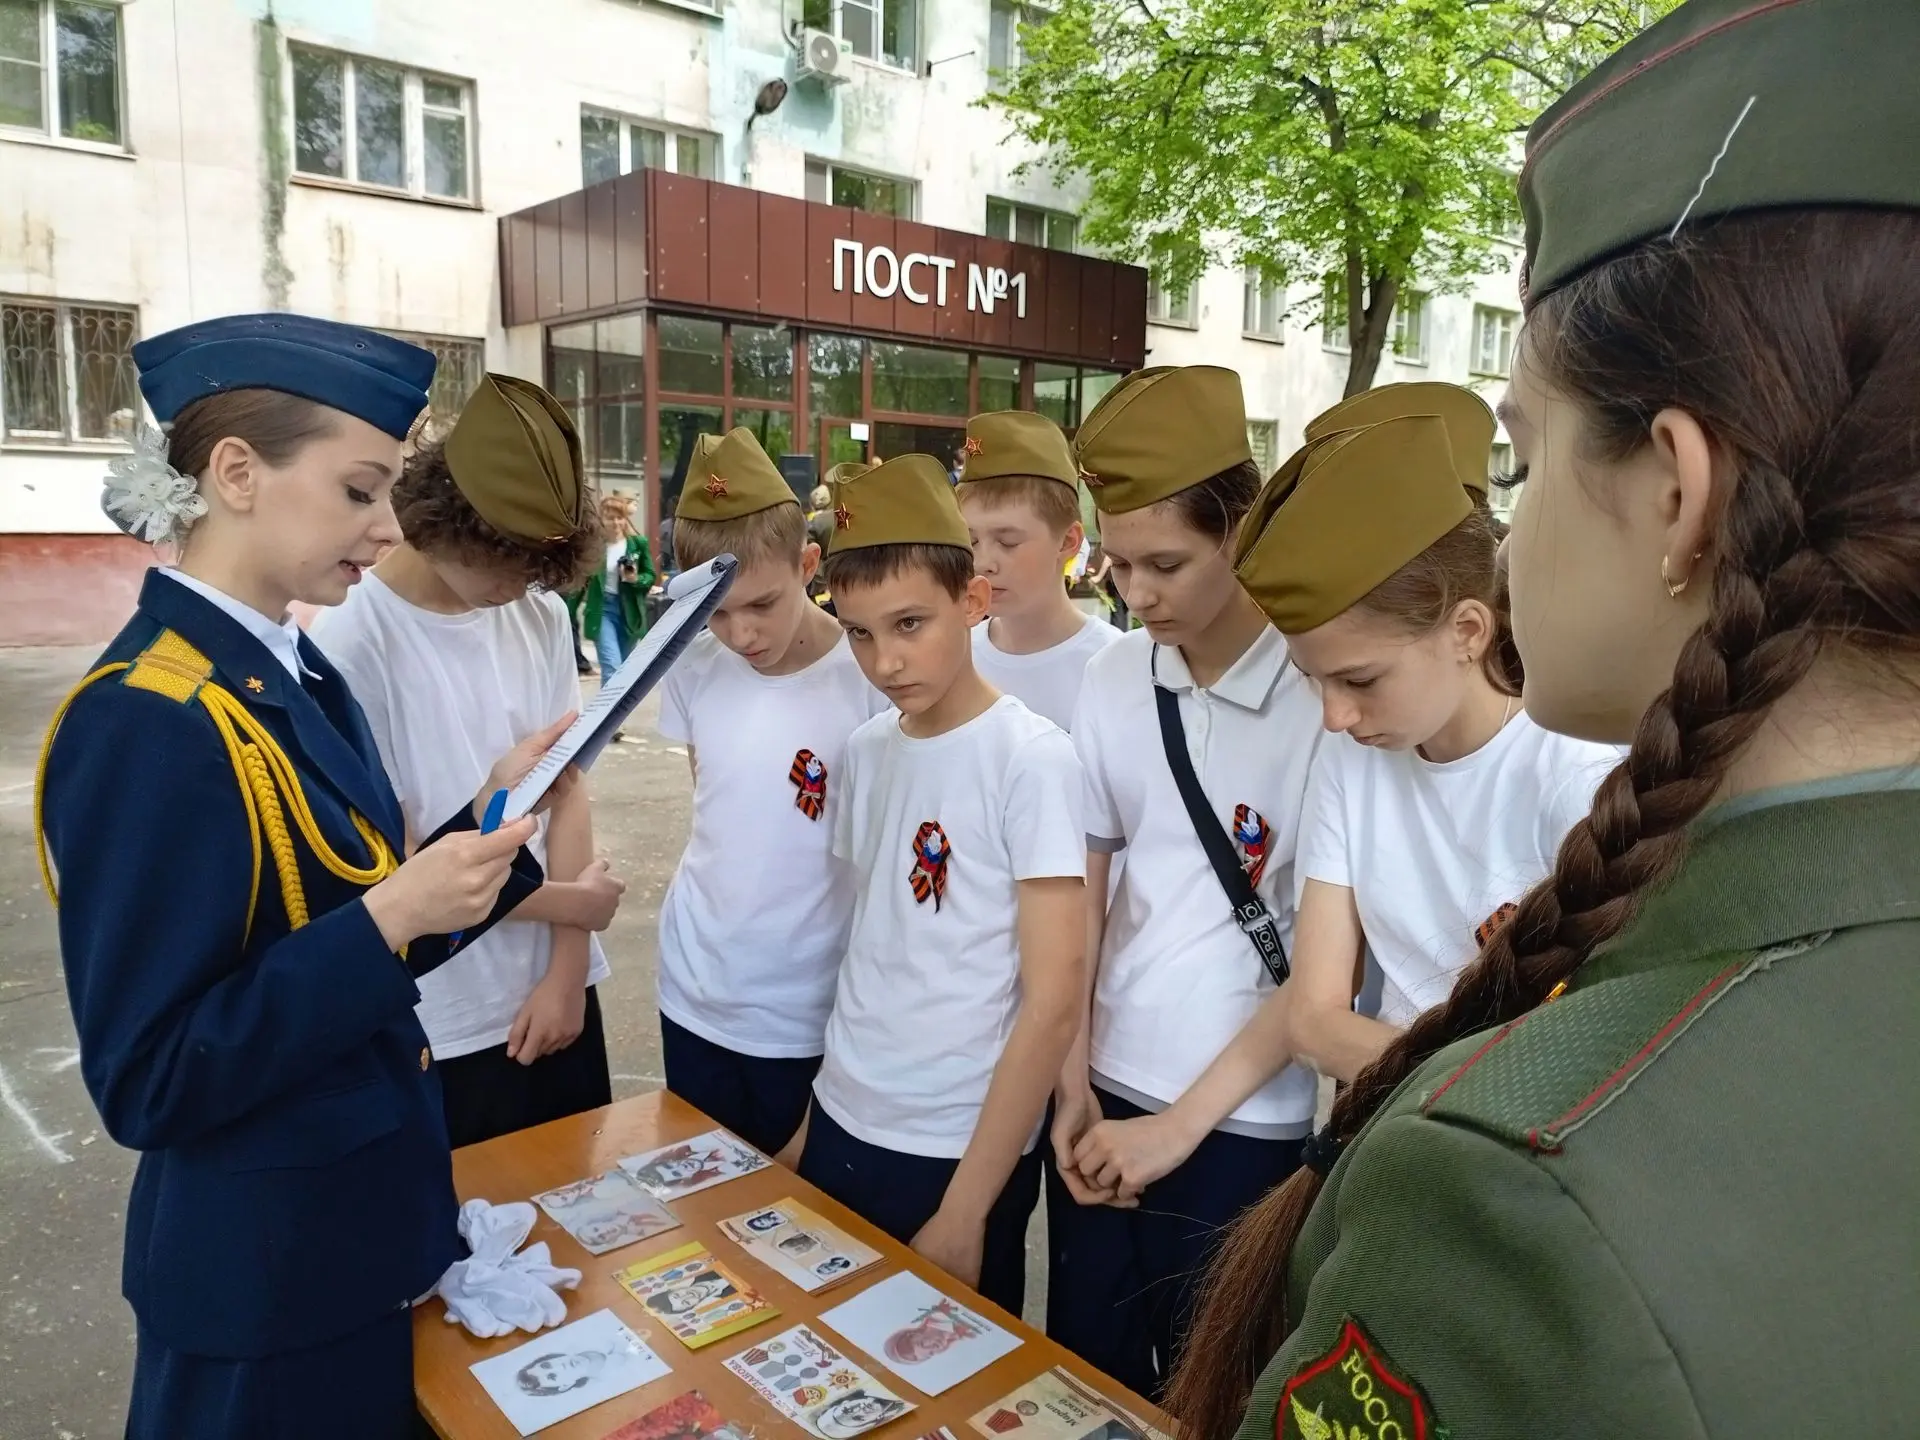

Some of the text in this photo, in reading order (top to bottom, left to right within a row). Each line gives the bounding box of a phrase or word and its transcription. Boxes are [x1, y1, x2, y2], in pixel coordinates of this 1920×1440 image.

[833, 238, 1026, 318] ПОСТ №1
[1341, 1348, 1407, 1440] РОСС
